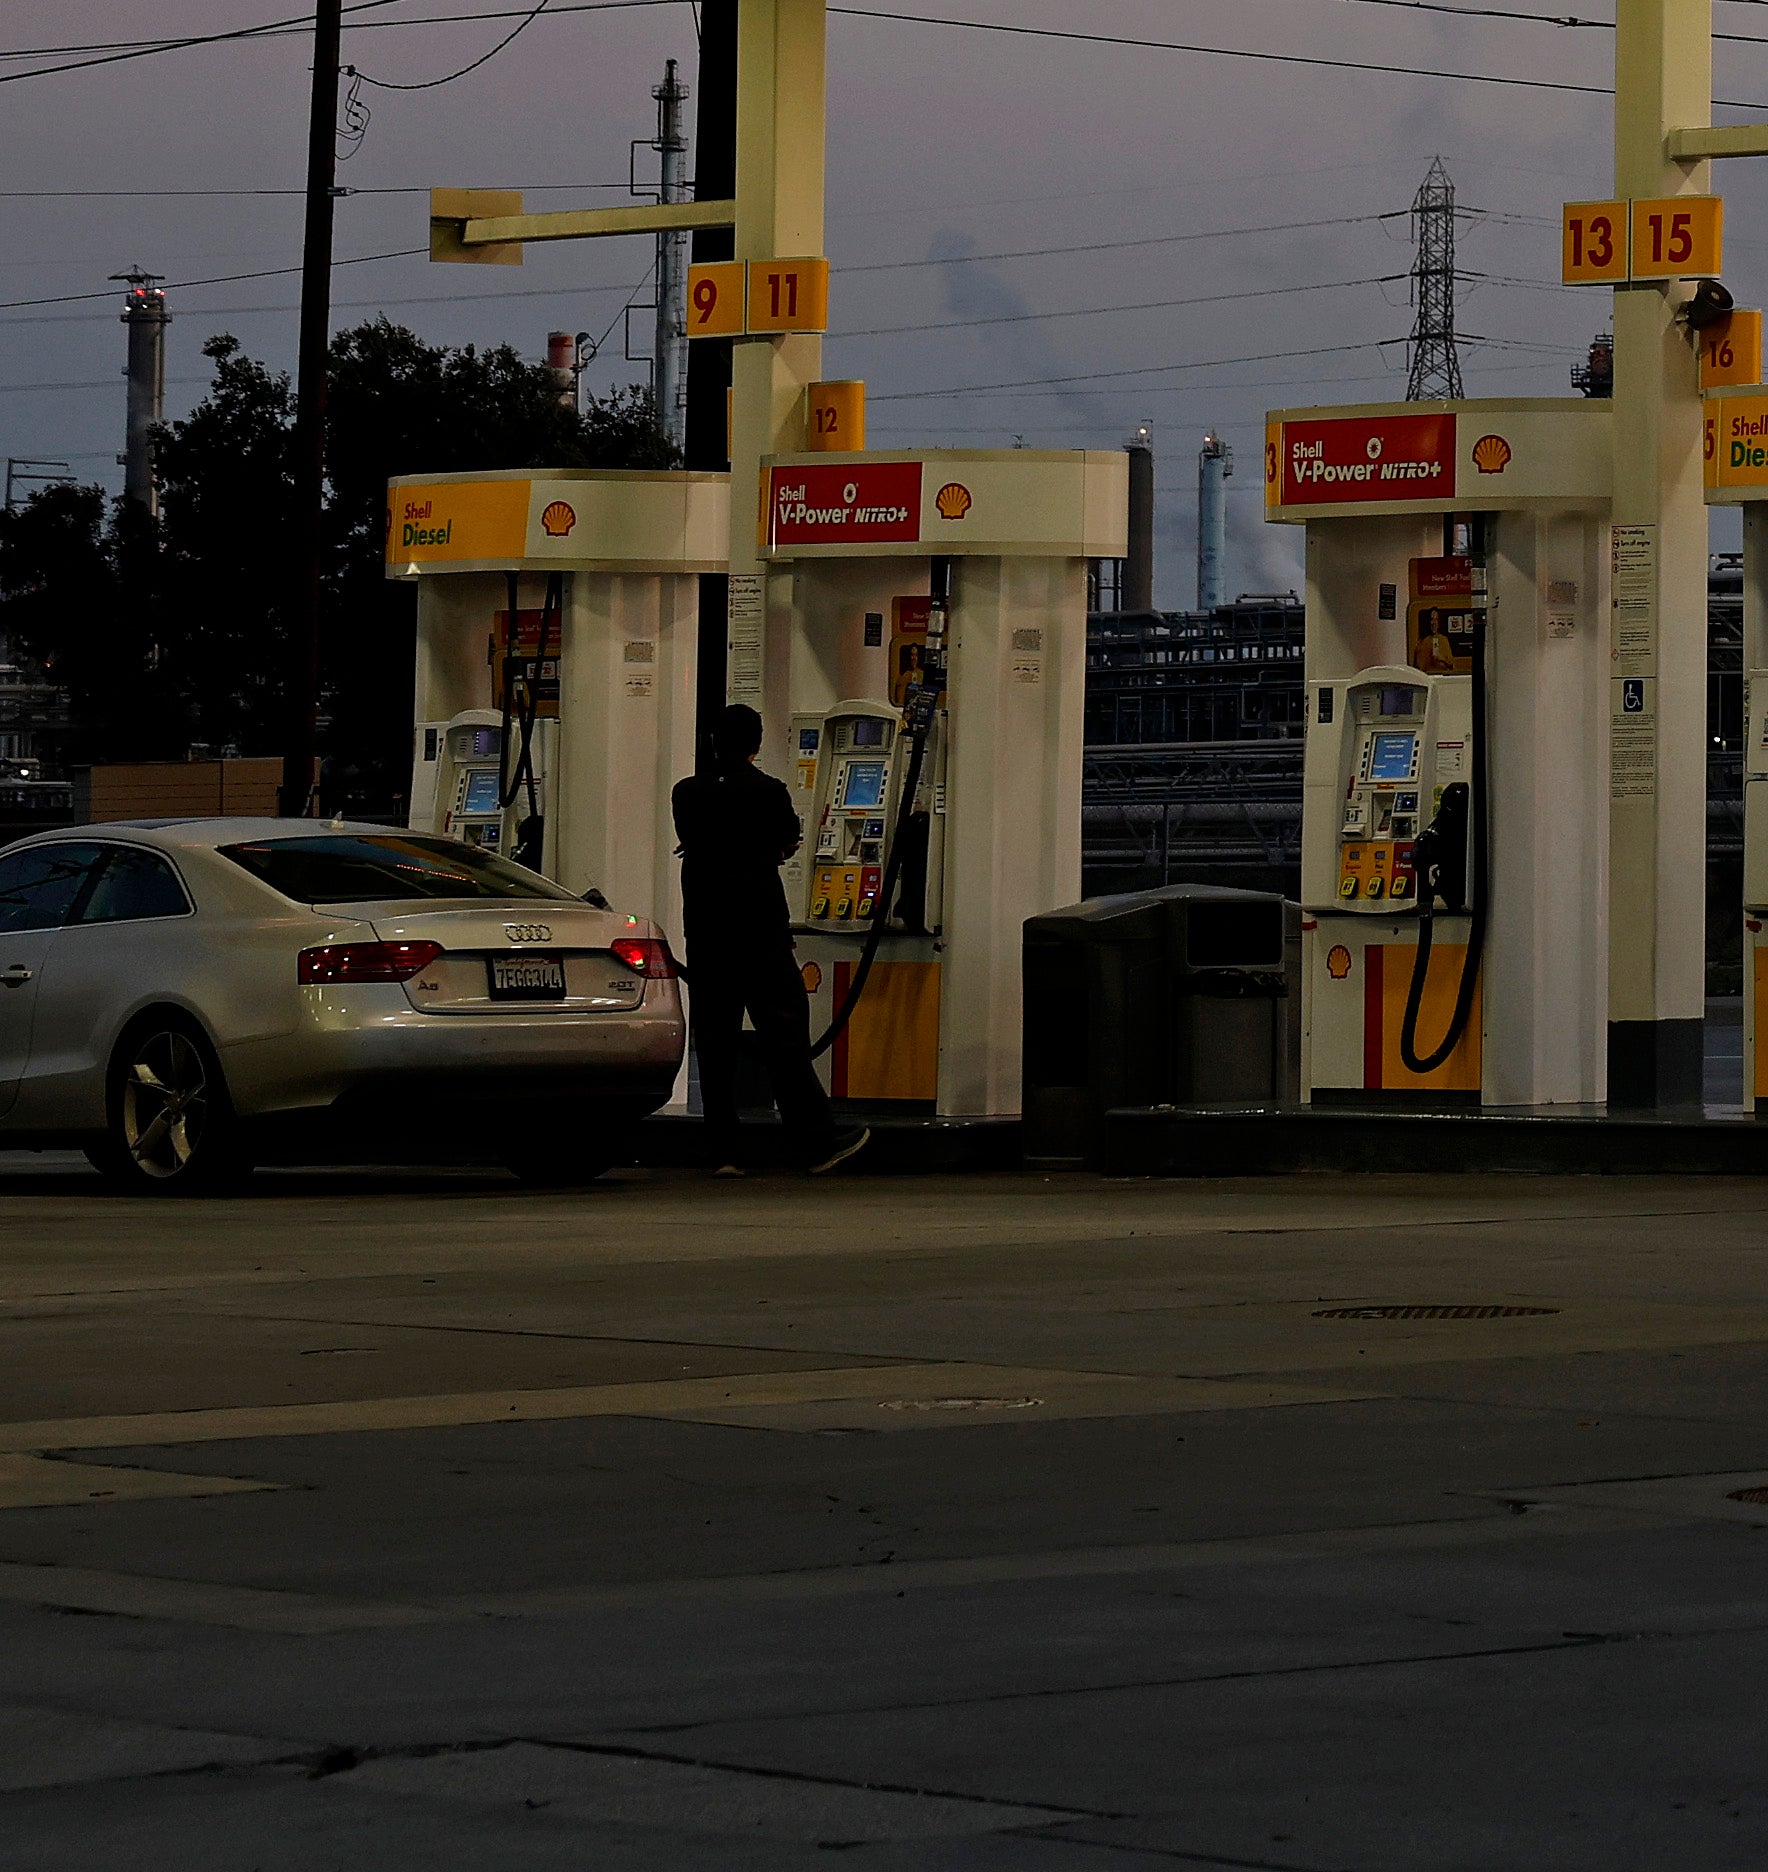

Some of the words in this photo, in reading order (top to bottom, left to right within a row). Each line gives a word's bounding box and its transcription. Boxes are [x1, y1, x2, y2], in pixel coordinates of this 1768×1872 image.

[1569, 216, 1613, 267] 13
[1649, 213, 1692, 262] 15
[693, 279, 717, 323] 9
[768, 273, 797, 317] 11
[1709, 340, 1734, 368] 16
[815, 407, 838, 433] 12
[1731, 414, 1768, 437] Shell
[1292, 440, 1323, 459] Shell
[1292, 460, 1375, 484] V-Power
[779, 484, 806, 502] Shell
[404, 500, 432, 520] Shell
[778, 503, 850, 525] V-Power
[403, 518, 452, 547] Diesel
